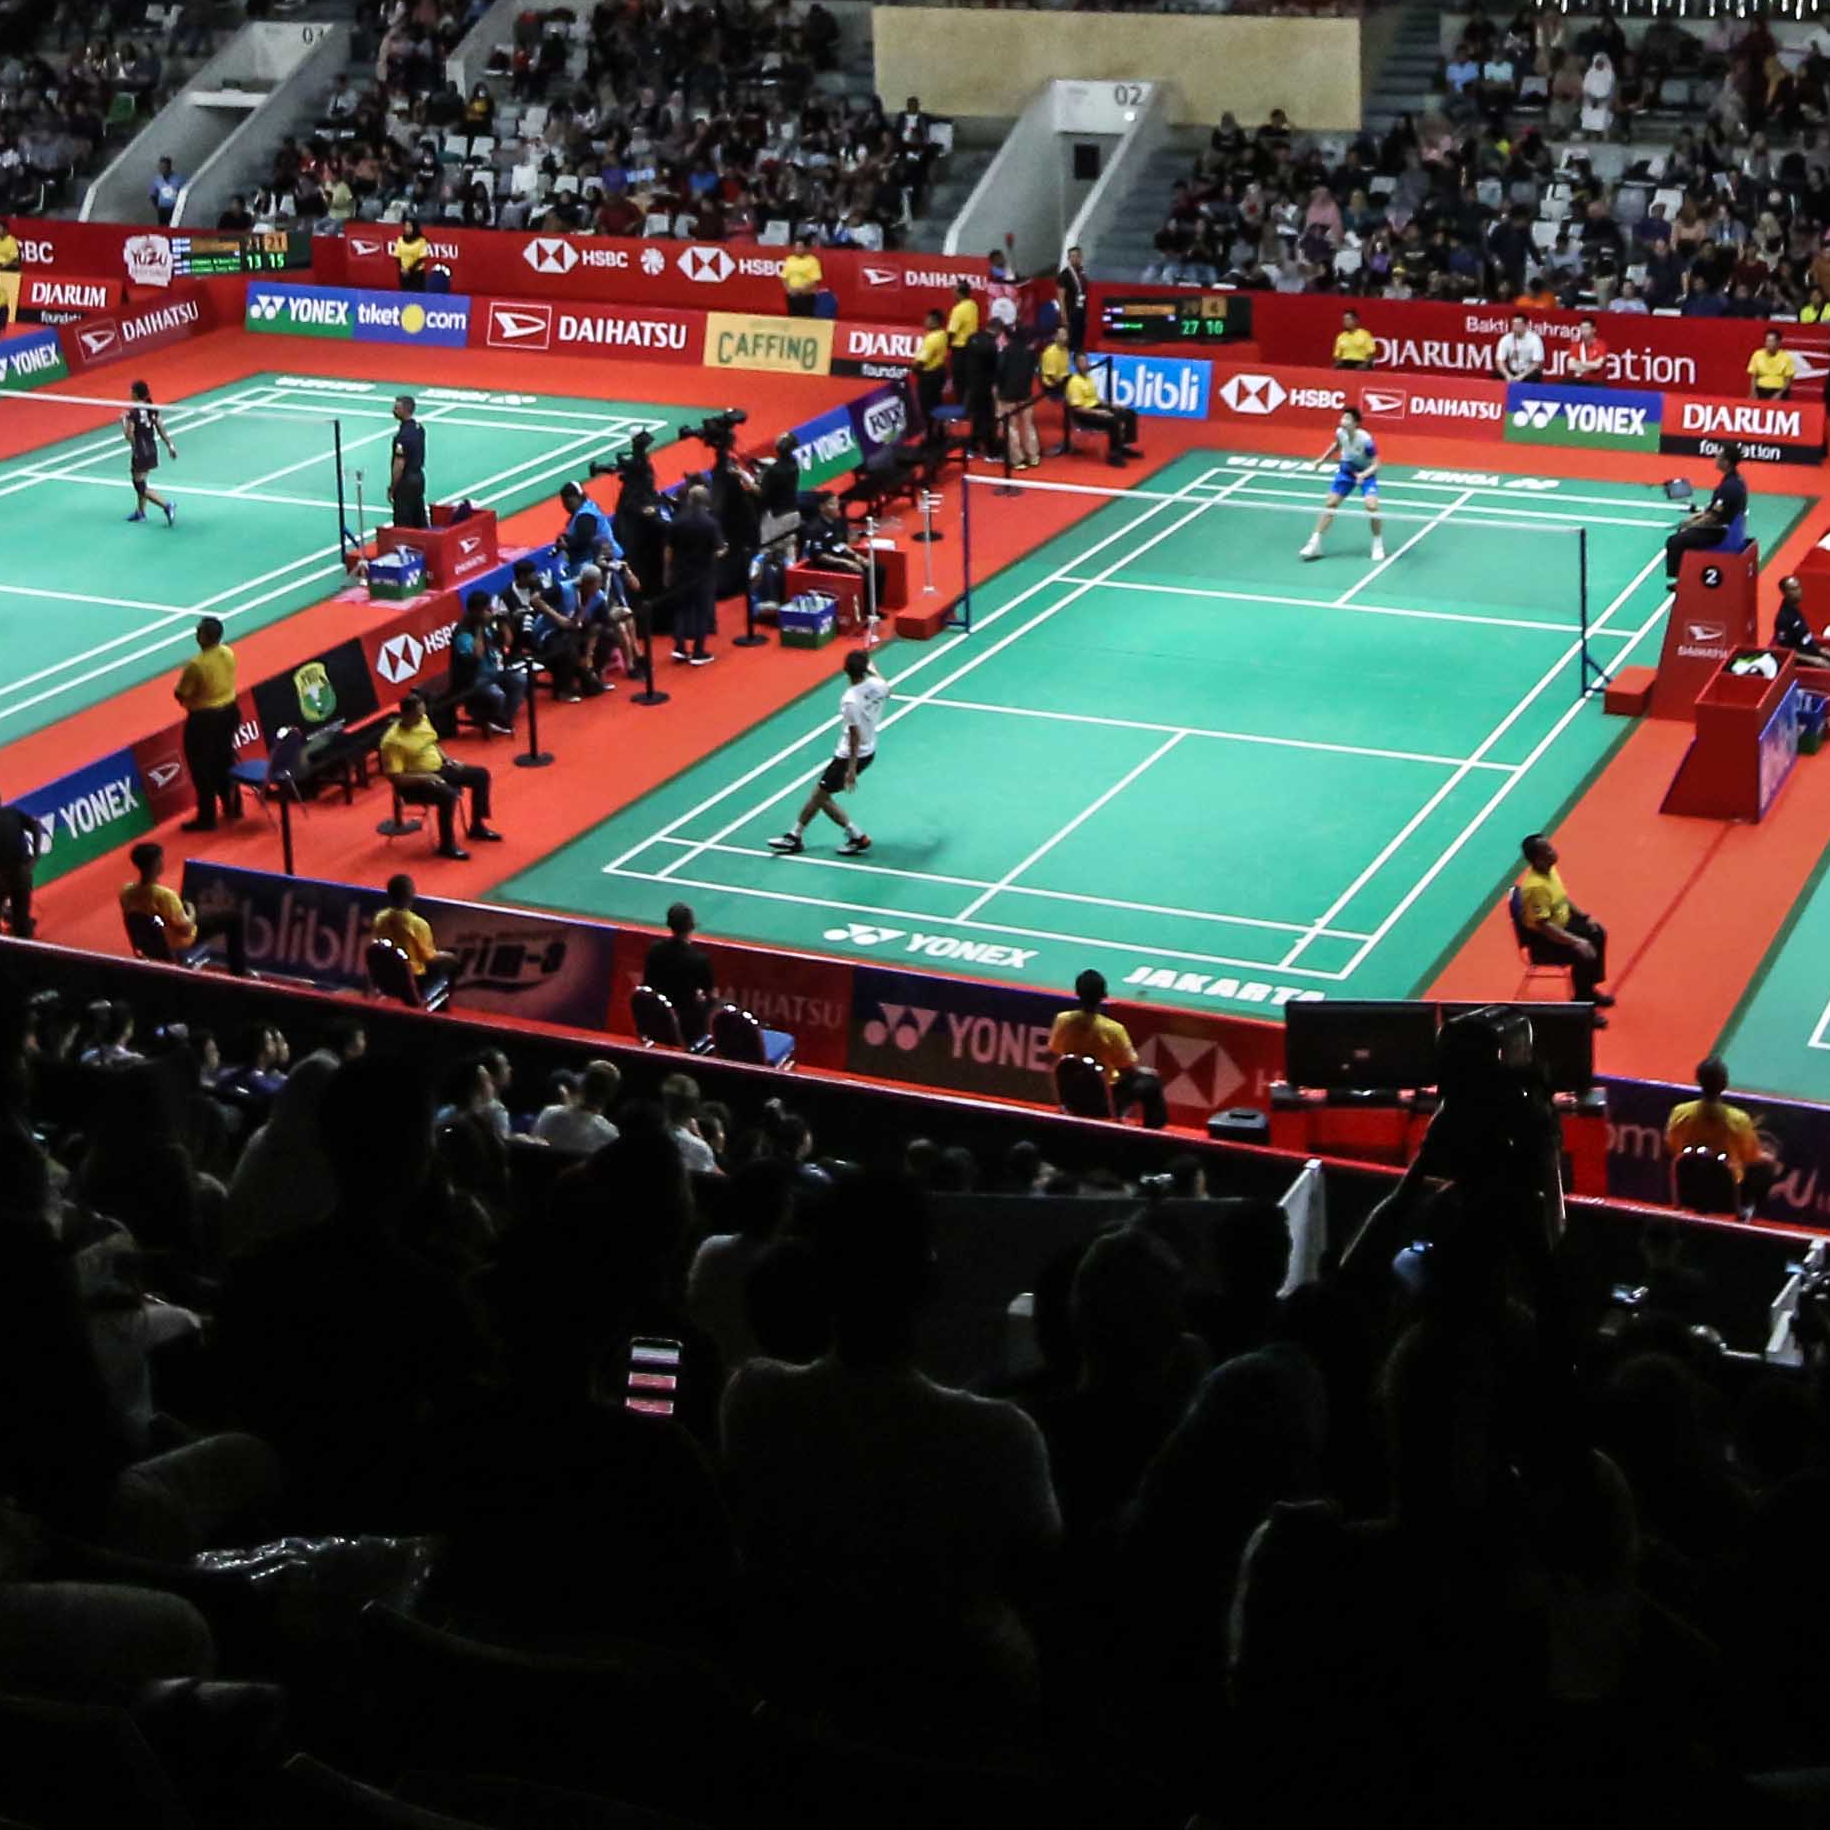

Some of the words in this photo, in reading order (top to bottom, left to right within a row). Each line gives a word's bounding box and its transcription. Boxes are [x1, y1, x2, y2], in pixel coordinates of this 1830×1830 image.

[1113, 85, 1143, 107] 02
[581, 249, 629, 268] HSBC
[31, 281, 107, 308] DJARUM
[122, 298, 200, 343] DAIHATSU
[288, 297, 349, 326] YONEX
[558, 316, 688, 349] DAIHATSU
[848, 330, 922, 358] DJARU
[10, 342, 60, 377] YONEX
[1111, 362, 1200, 413] blibli
[1289, 387, 1346, 411] HSBC
[1410, 396, 1502, 421] DAIHATSU
[1564, 404, 1647, 437] YONEX
[1683, 403, 1802, 438] DJARUM
[1704, 569, 1719, 586] 2
[61, 776, 139, 840] YONEX
[903, 931, 1040, 969] YONEX
[949, 1012, 1054, 1071] YONE
